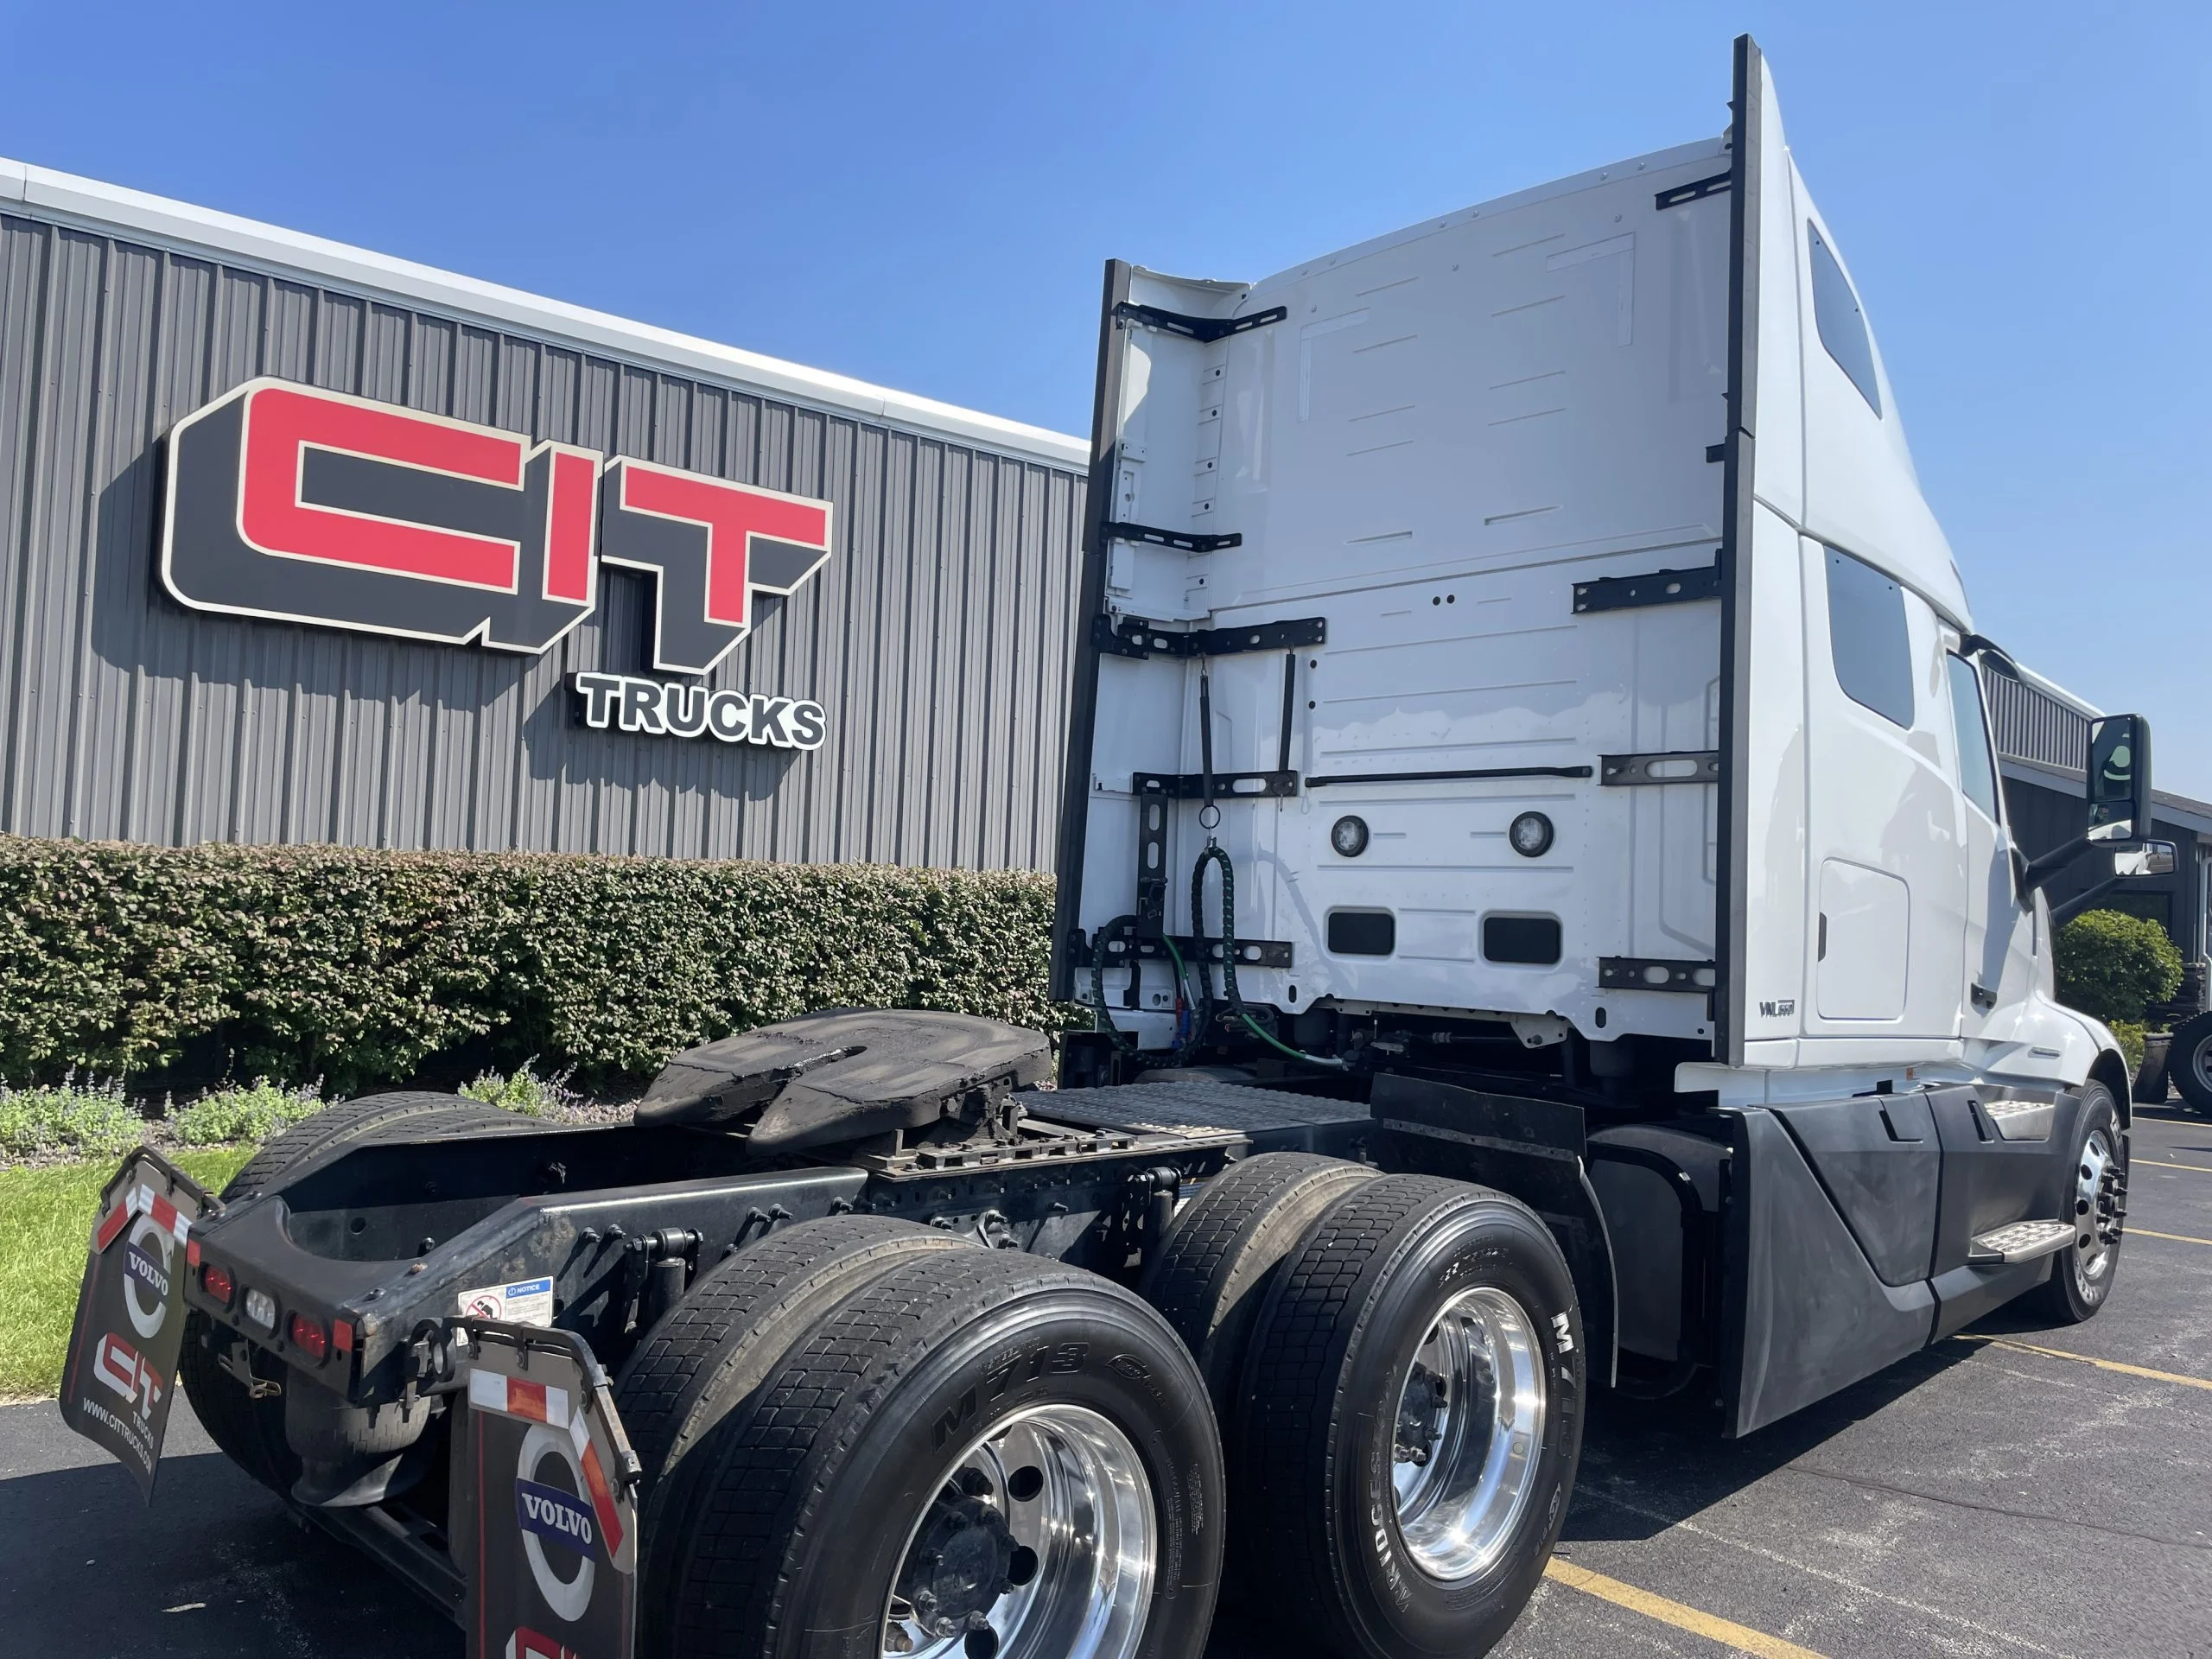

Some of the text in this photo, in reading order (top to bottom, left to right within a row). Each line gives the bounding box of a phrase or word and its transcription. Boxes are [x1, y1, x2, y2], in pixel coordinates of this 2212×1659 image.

[161, 375, 834, 676] CIT
[576, 671, 827, 751] TRUCKS
[129, 1250, 168, 1296] VOLVO
[517, 1283, 541, 1294] NOTICE
[93, 1332, 163, 1421] CIT
[521, 1492, 593, 1545] VOLVO
